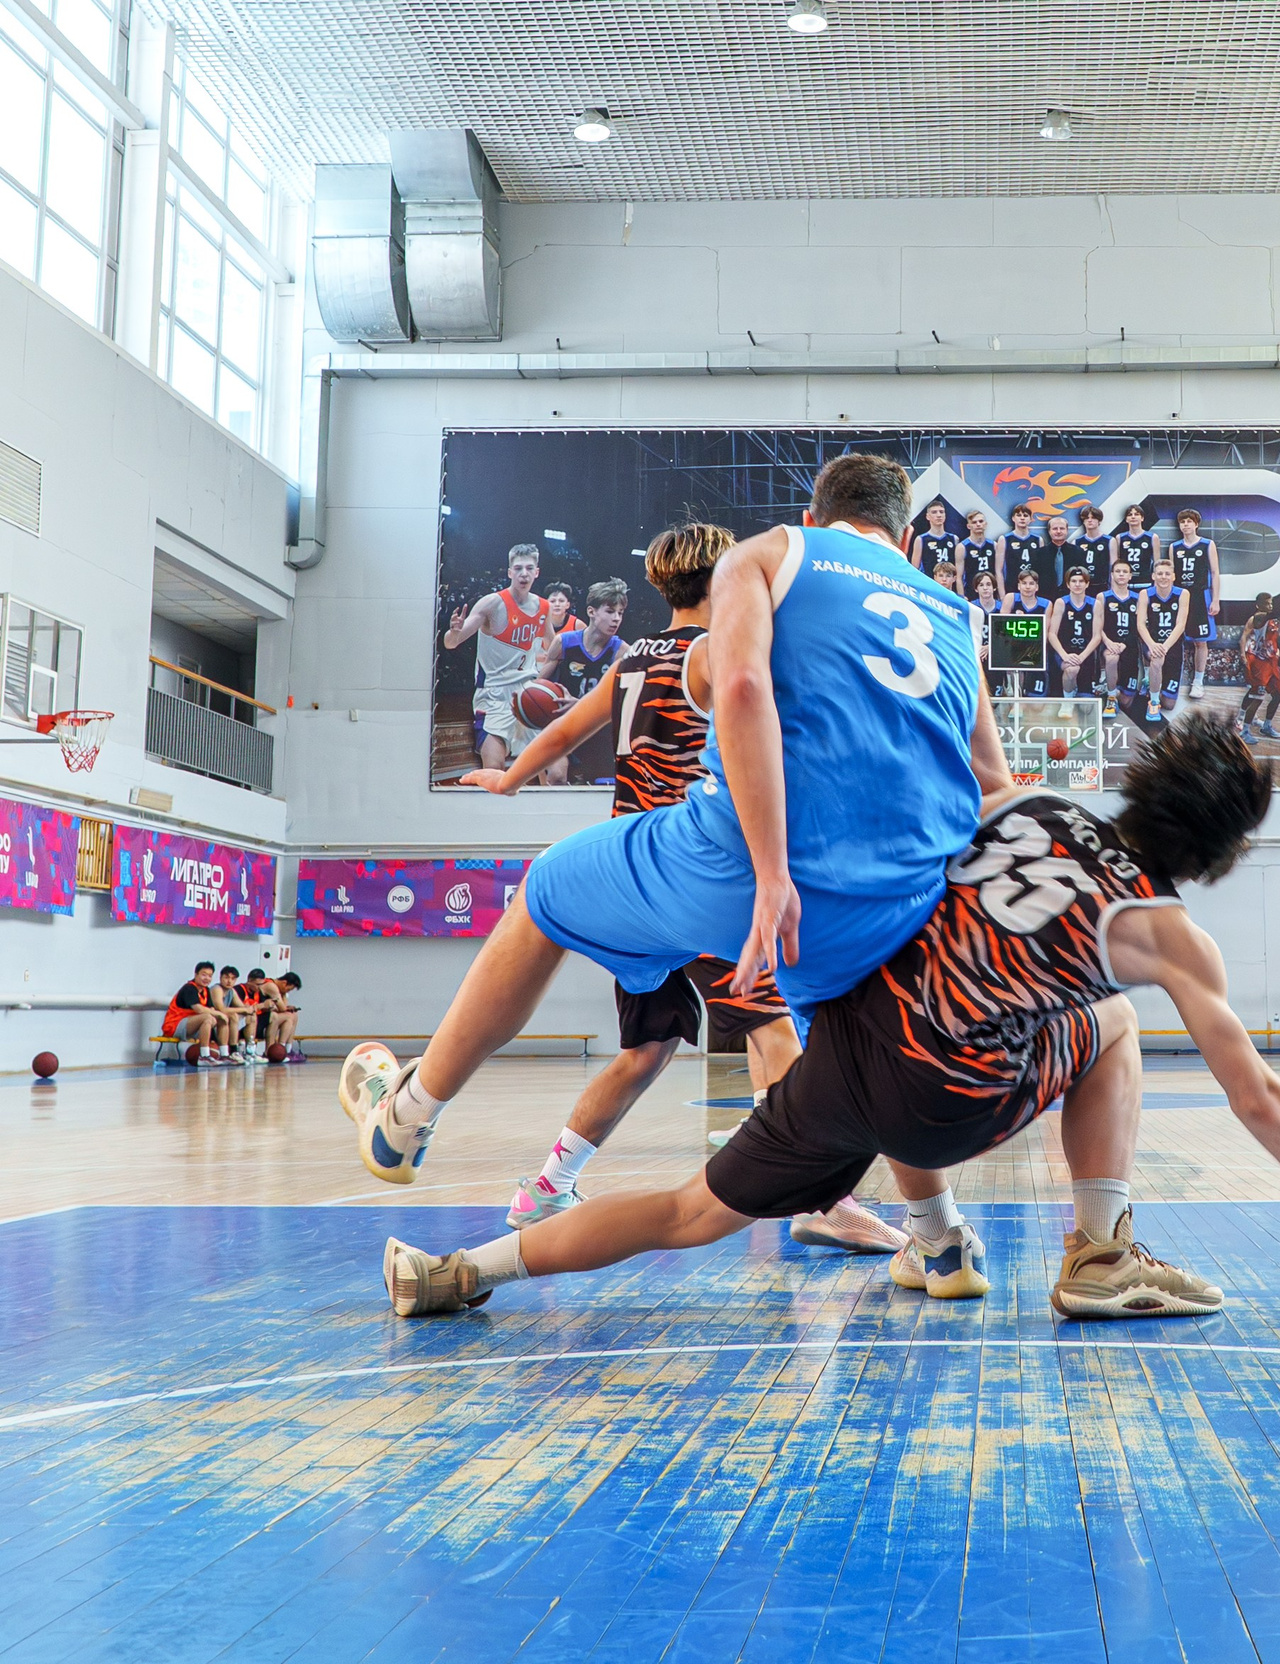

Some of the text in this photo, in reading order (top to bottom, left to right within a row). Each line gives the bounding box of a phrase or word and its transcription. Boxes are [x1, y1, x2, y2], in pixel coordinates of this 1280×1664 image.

[936, 547, 949, 562] 34
[1021, 549, 1030, 562] 4
[1086, 550, 1094, 564] 8
[1127, 548, 1141, 562] 22
[978, 557, 989, 570] 23
[1182, 557, 1195, 571] 15
[811, 559, 918, 600] ХАБАРОВСКОЕ
[1116, 611, 1129, 627] 19
[1158, 611, 1172, 627] 12
[1074, 620, 1082, 635] 5
[1198, 624, 1209, 636] 15
[862, 591, 940, 699] 3
[1034, 680, 1044, 692] 11
[1127, 677, 1137, 690] 19
[1167, 679, 1178, 692] 12
[183, 884, 229, 914] ДЕТЯМ
[391, 895, 410, 903] РФБ
[444, 915, 471, 923] ФБХК
